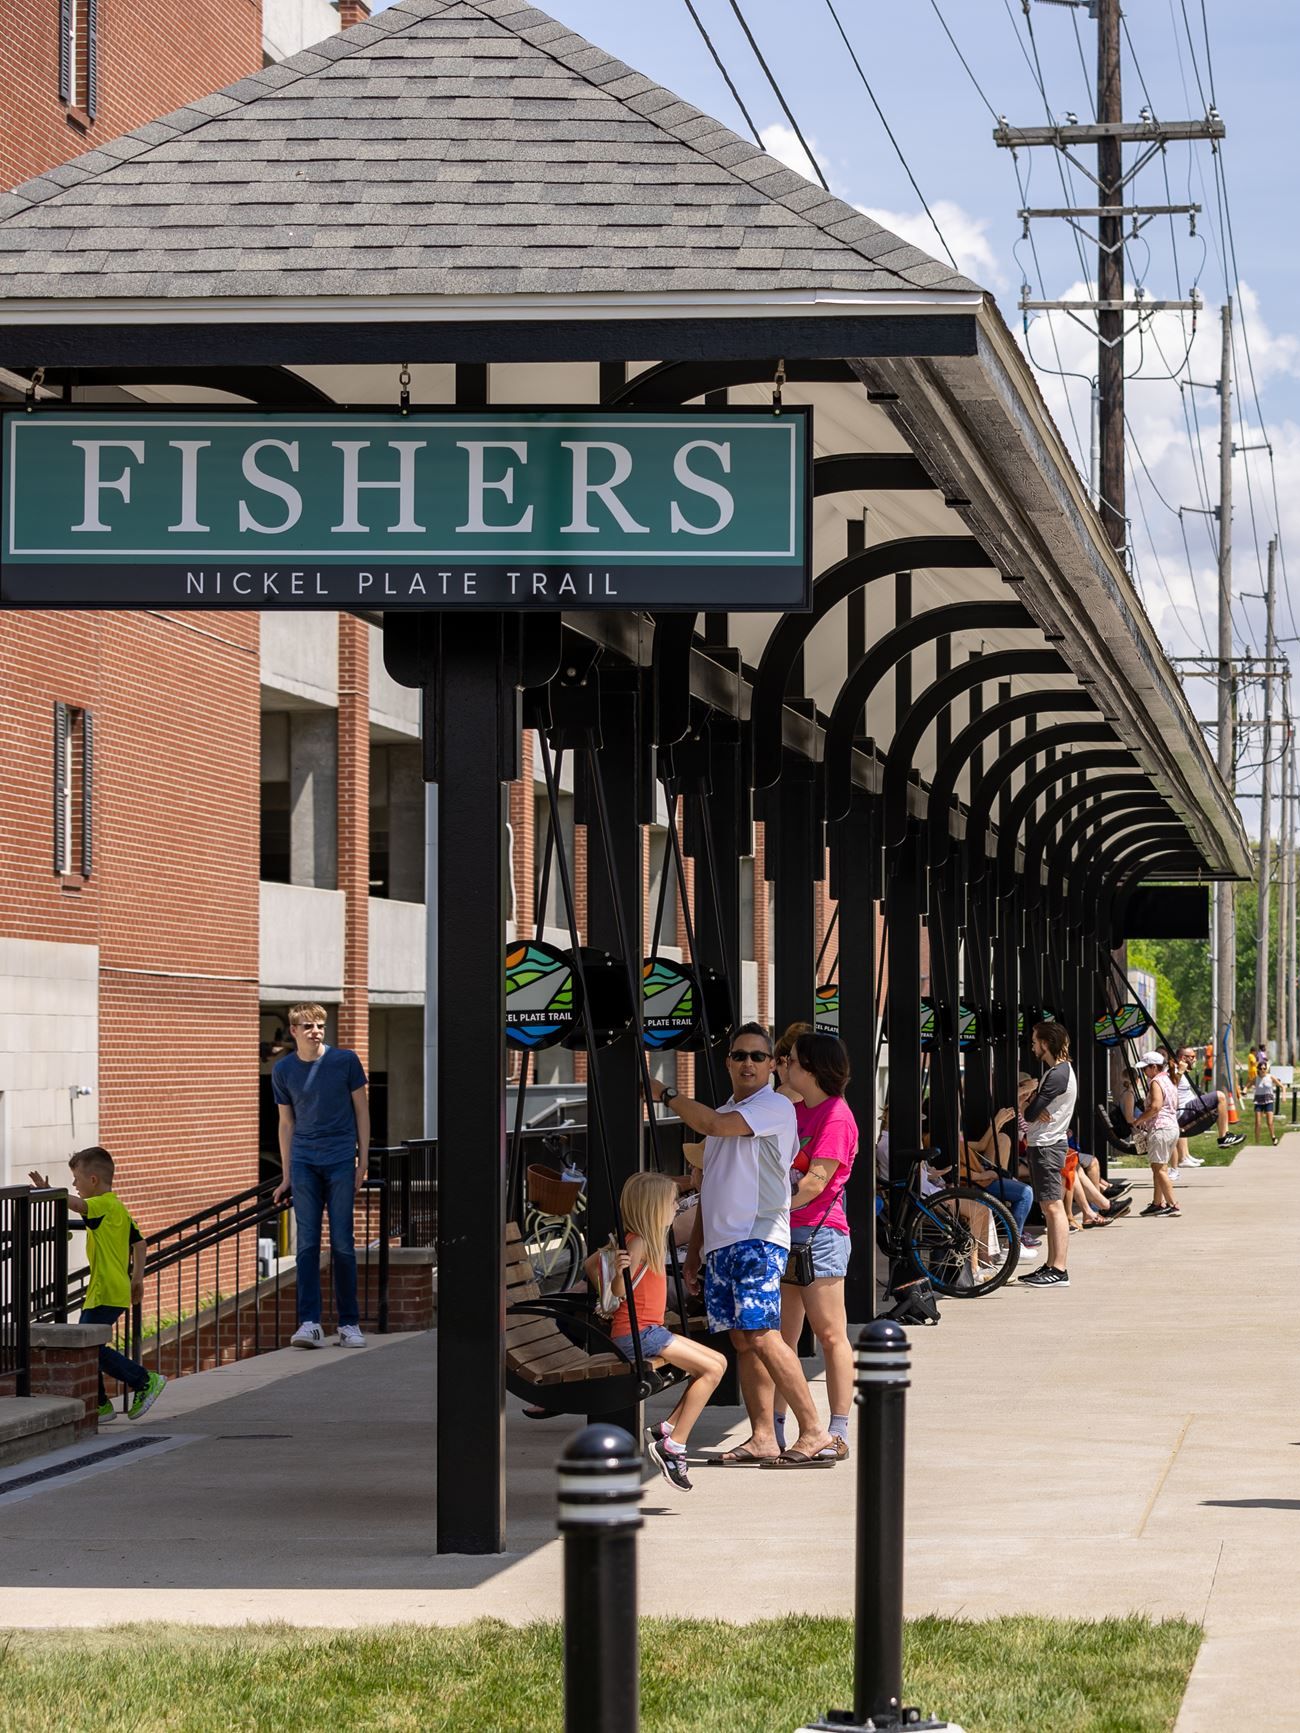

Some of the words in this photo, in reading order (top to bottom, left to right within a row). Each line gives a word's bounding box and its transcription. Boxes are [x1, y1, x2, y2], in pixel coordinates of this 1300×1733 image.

[70, 438, 735, 536] FISHERS
[187, 571, 329, 595] NICKEL
[358, 571, 478, 595] PLATE
[506, 571, 618, 595] TRAIL
[519, 1012, 546, 1021] PLATE
[548, 1011, 573, 1021] TRAIL
[647, 1019, 670, 1027] PLATE
[671, 1018, 693, 1026] TRAIL
